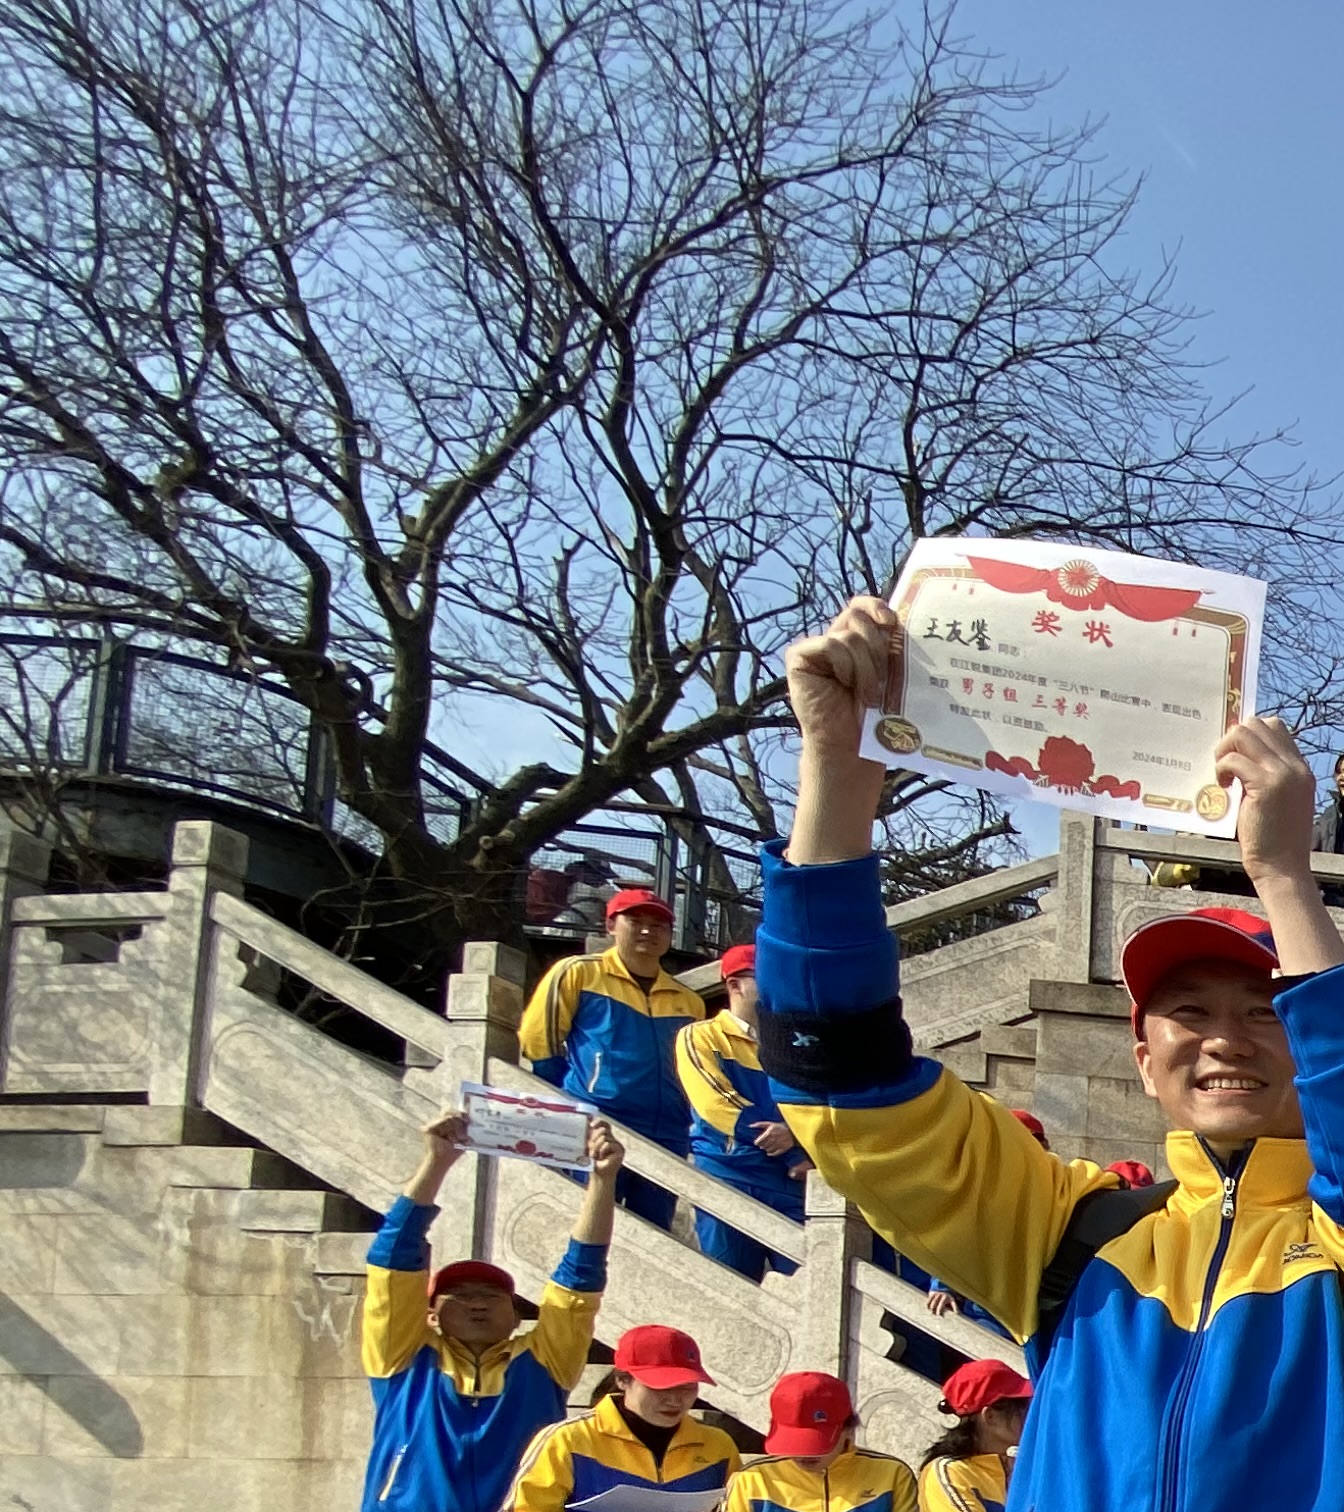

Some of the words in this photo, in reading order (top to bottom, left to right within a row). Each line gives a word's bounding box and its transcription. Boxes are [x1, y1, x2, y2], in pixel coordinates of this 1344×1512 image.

[1032, 610, 1114, 648] 奖状
[1032, 694, 1090, 720] 三等奖
